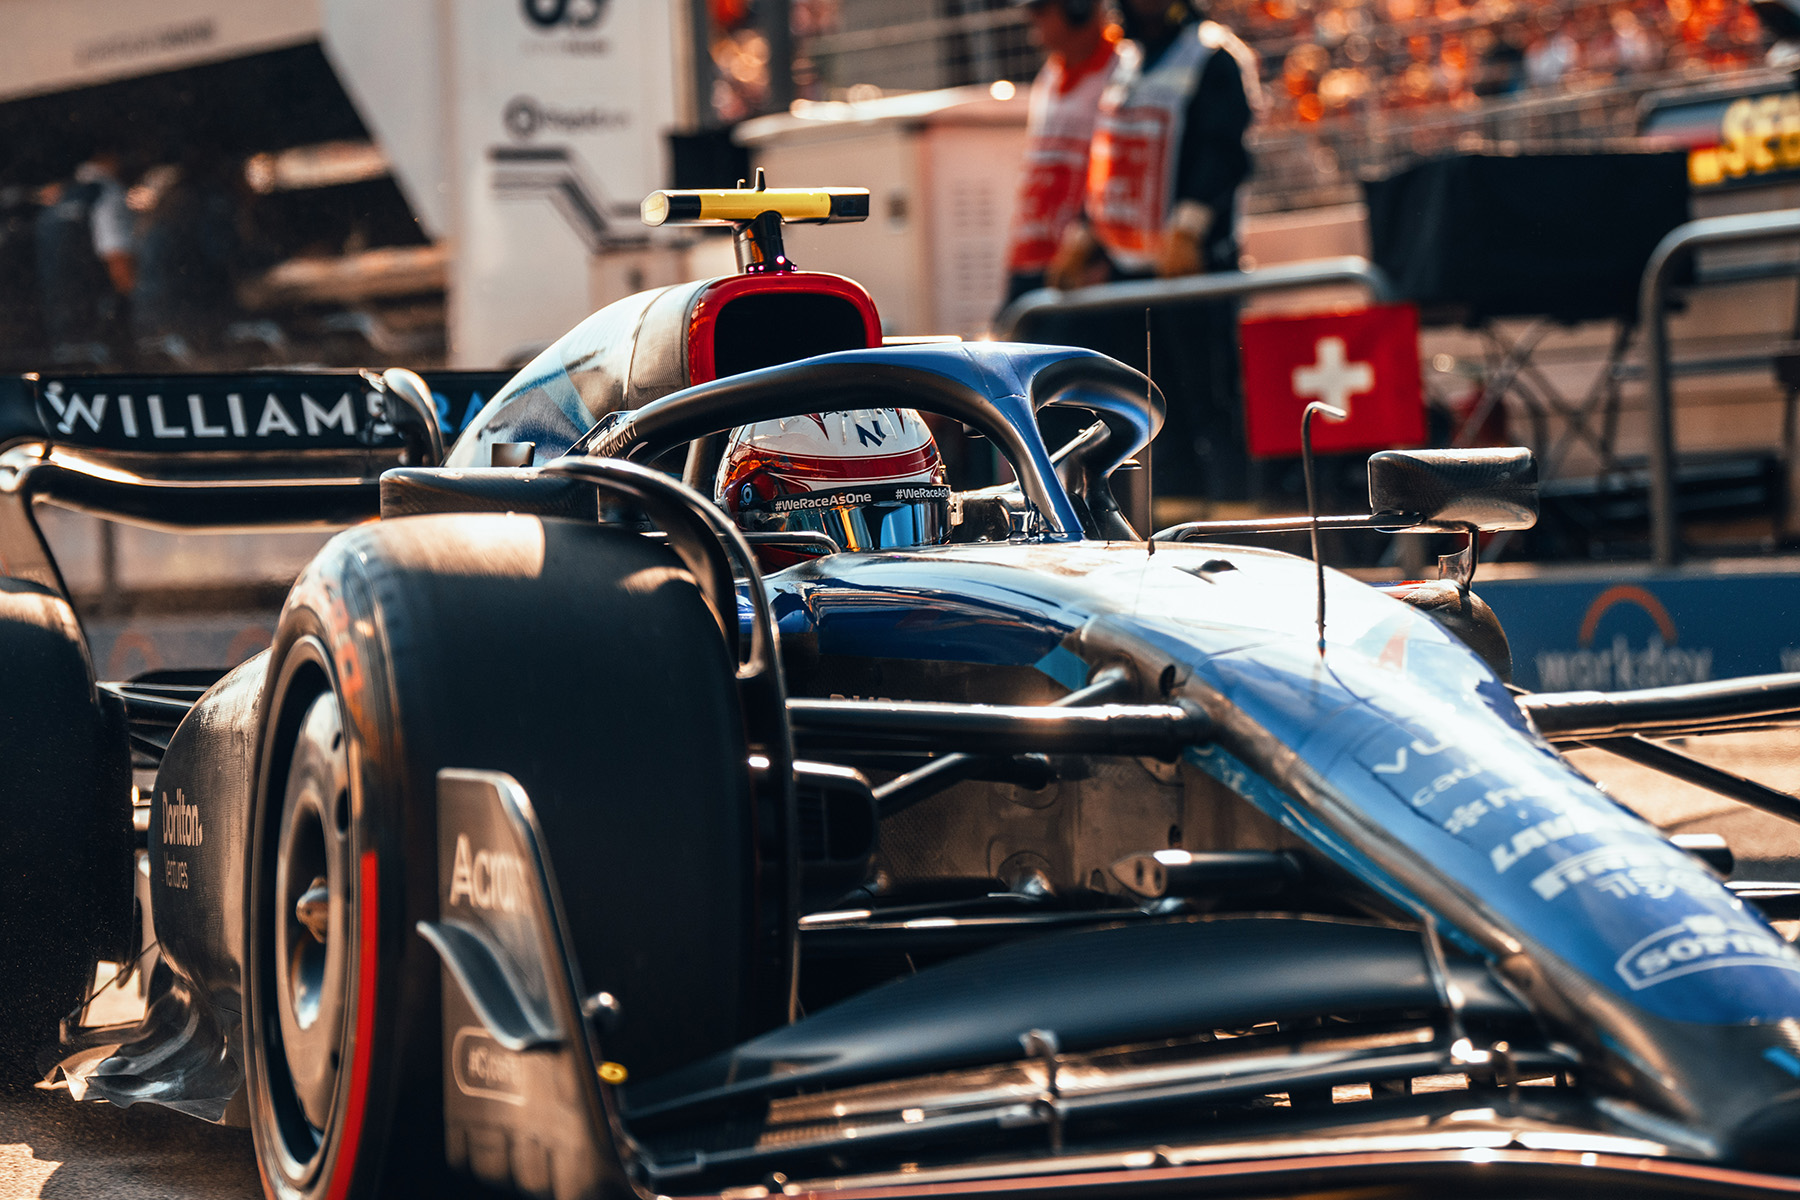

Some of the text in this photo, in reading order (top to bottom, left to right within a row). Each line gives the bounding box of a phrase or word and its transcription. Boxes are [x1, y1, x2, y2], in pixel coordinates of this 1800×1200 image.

[775, 493, 872, 513] #WeRaceAsOne
[895, 487, 950, 500] #WeRaceAsO
[162, 788, 199, 847] Dorilton
